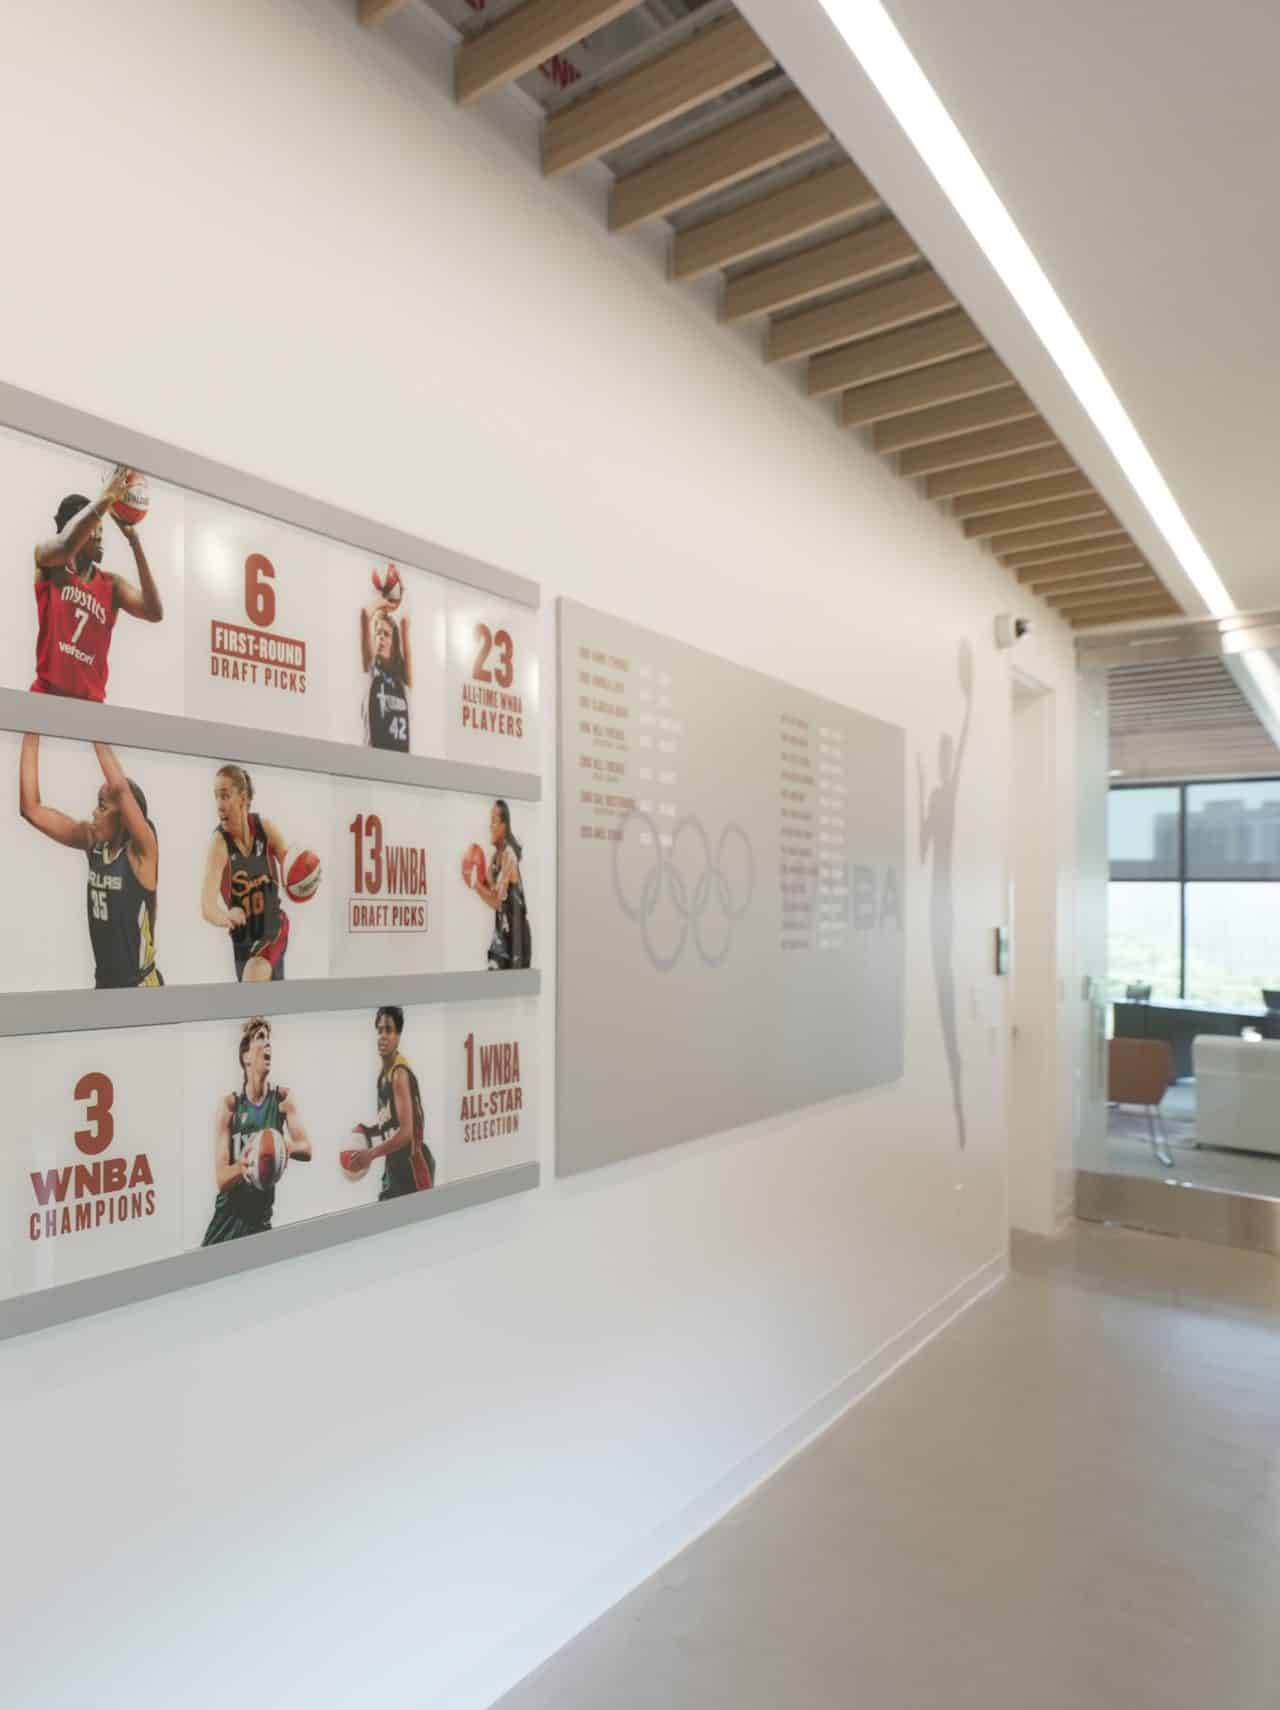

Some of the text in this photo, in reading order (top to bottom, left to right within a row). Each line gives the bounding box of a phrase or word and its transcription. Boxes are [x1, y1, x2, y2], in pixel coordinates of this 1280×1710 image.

[244, 553, 276, 628] 6
[74, 608, 89, 643] 7
[215, 626, 303, 667] FIRST-ROUND
[472, 623, 513, 689] 23
[211, 655, 306, 693] DRAFT PICKS
[389, 716, 407, 740] 42
[463, 705, 522, 738] PLAYERS
[349, 813, 383, 895] 13
[385, 845, 427, 895] WNBA
[352, 904, 424, 928] DRAFT PICKS
[464, 1032, 520, 1090] 1 WNBA
[73, 1072, 114, 1156] 3
[461, 1087, 522, 1121] ALL-STAR
[464, 1114, 519, 1143] SELECTION
[30, 1153, 154, 1206] WNBA
[29, 1189, 156, 1241] CHAMPIONS
